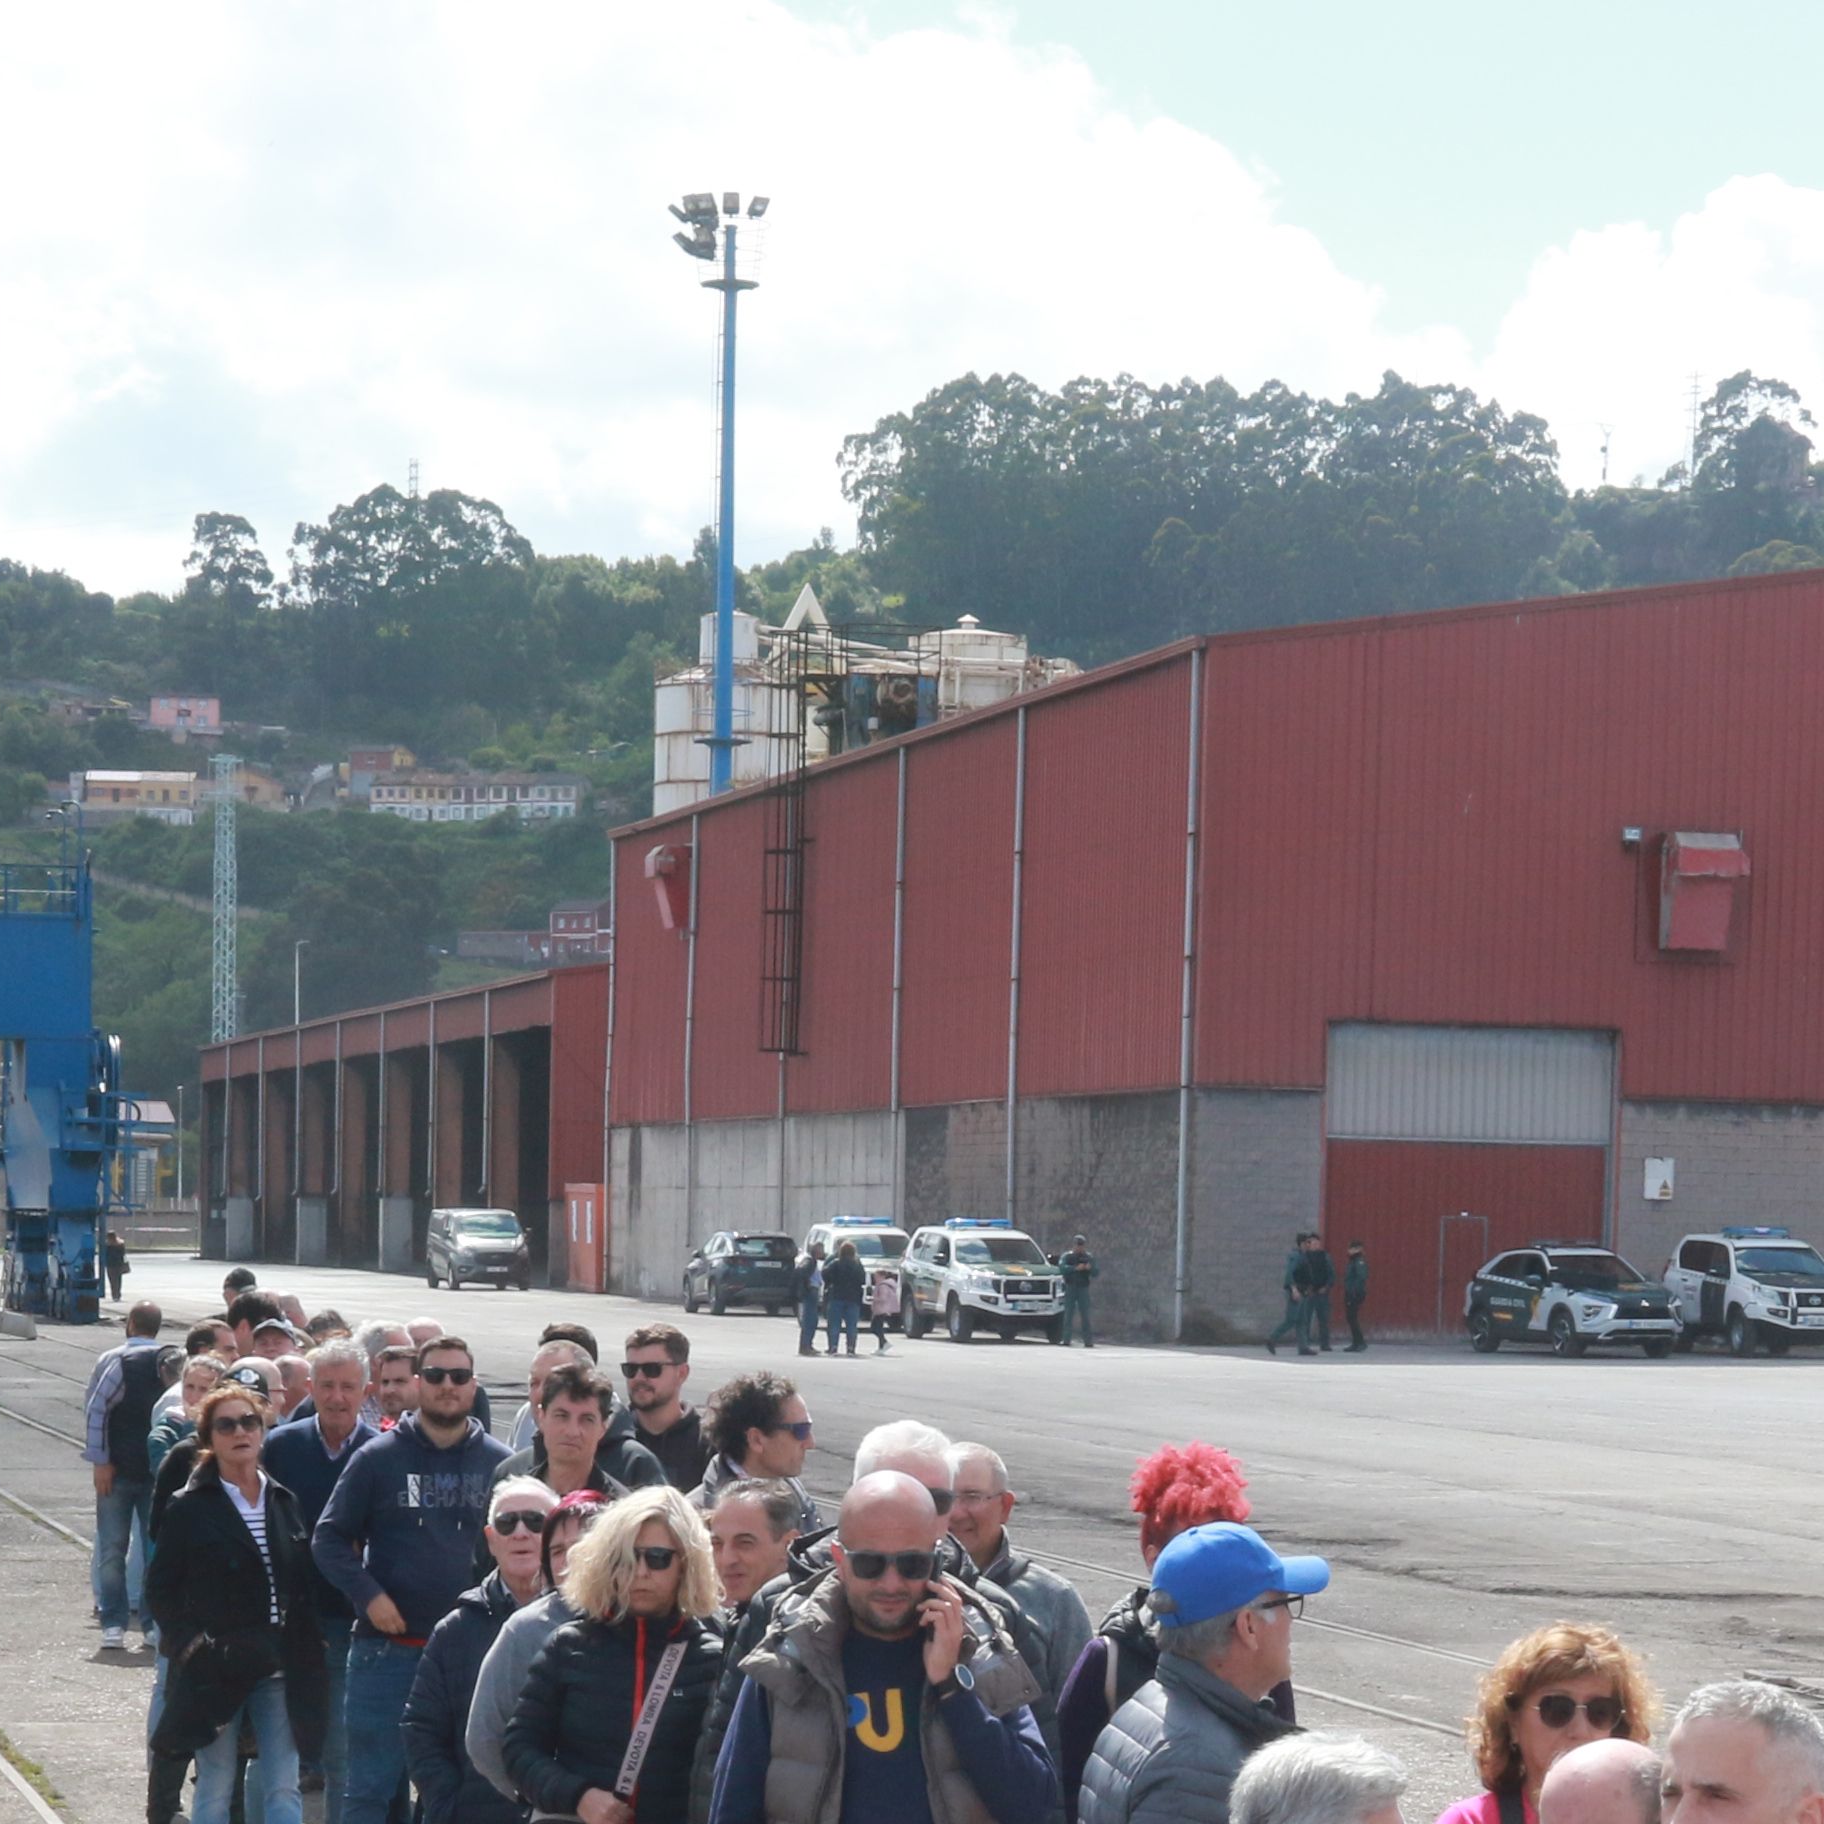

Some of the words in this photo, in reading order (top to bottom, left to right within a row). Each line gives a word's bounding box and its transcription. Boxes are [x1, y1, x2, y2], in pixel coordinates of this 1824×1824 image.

[397, 1490, 488, 1508] EXCHANG
[408, 1472, 485, 1491] ARMANI
[659, 1646, 680, 1681] DEVOTA
[641, 1690, 662, 1726] LOMBA
[626, 1730, 647, 1772] DEVOTA
